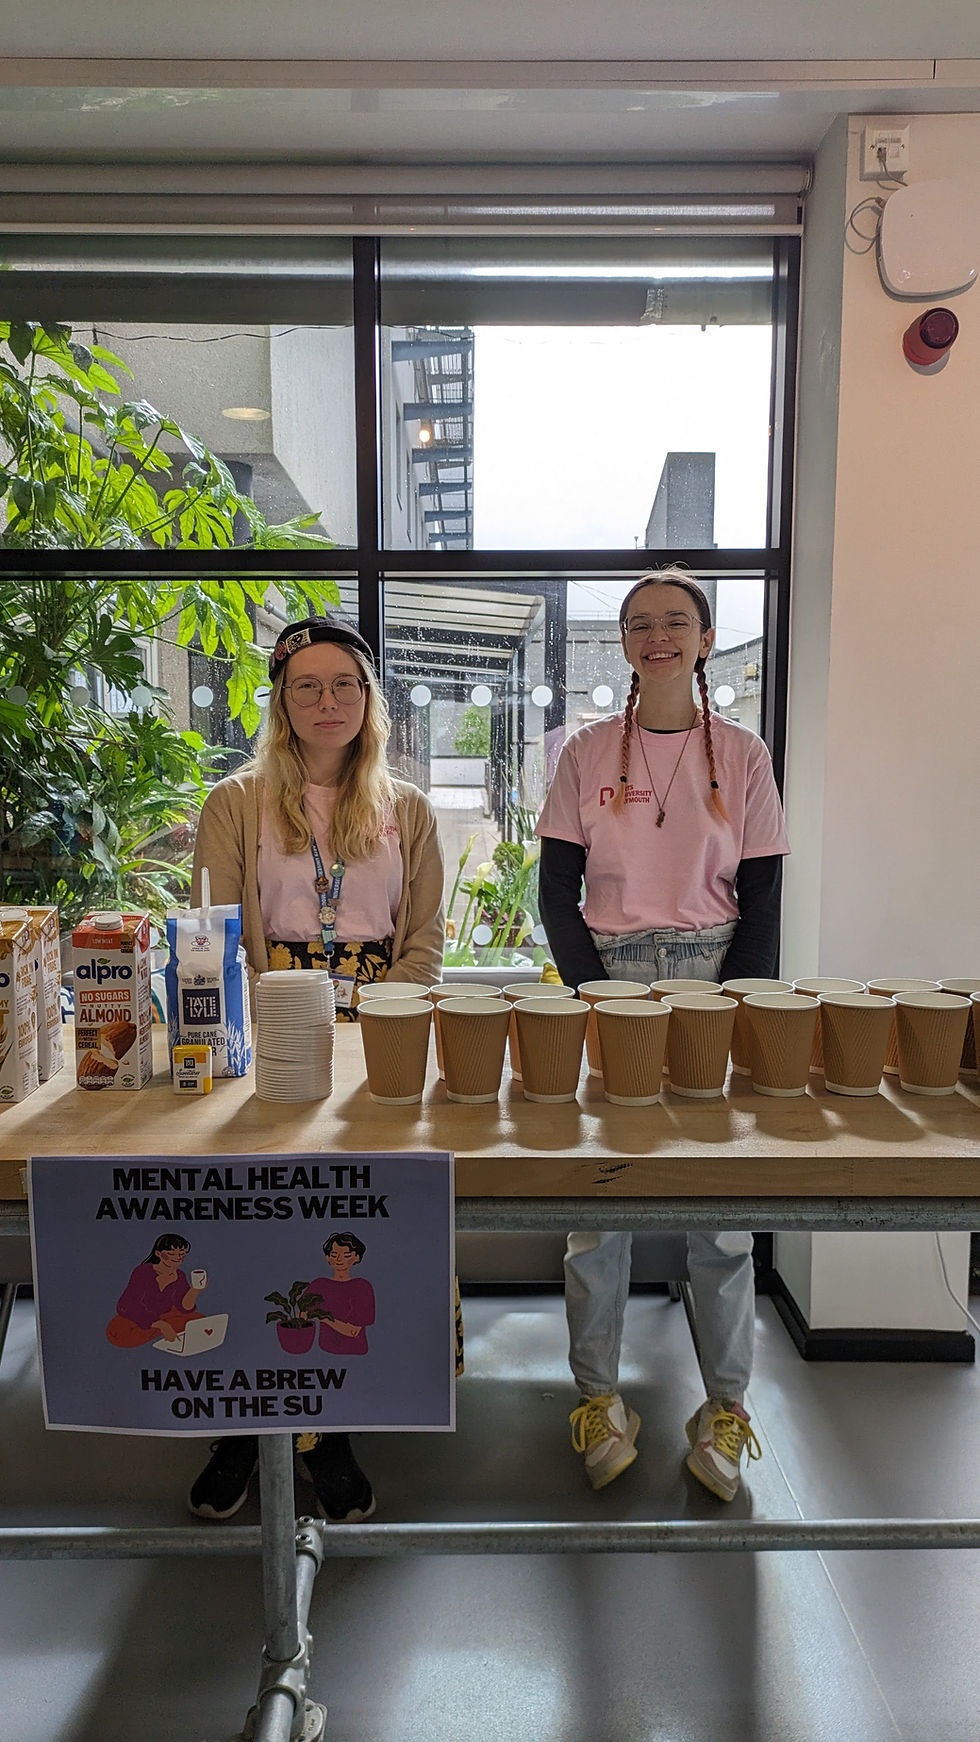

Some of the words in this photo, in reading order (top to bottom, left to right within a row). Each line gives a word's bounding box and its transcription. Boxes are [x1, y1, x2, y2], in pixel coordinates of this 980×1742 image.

[76, 958, 133, 985] alpro
[81, 993, 94, 1002] NO
[95, 991, 130, 1001] SUGARS
[186, 996, 216, 1007] TATE
[80, 1008, 132, 1023] ALMOND
[190, 1007, 217, 1018] LYLE
[182, 1036, 226, 1046] GRANULATED
[187, 1031, 202, 1039] PURE
[78, 1041, 98, 1049] CEREAL
[112, 1166, 244, 1192] MENTAL
[247, 1165, 371, 1190] HEALTH
[95, 1196, 294, 1221] AWARENESS
[298, 1194, 390, 1220] WEEK
[140, 1369, 224, 1391] HAVE
[229, 1369, 251, 1390] A
[256, 1368, 347, 1390] BREW
[171, 1395, 215, 1419] ON
[221, 1395, 279, 1418] THE
[283, 1394, 323, 1417] SU
